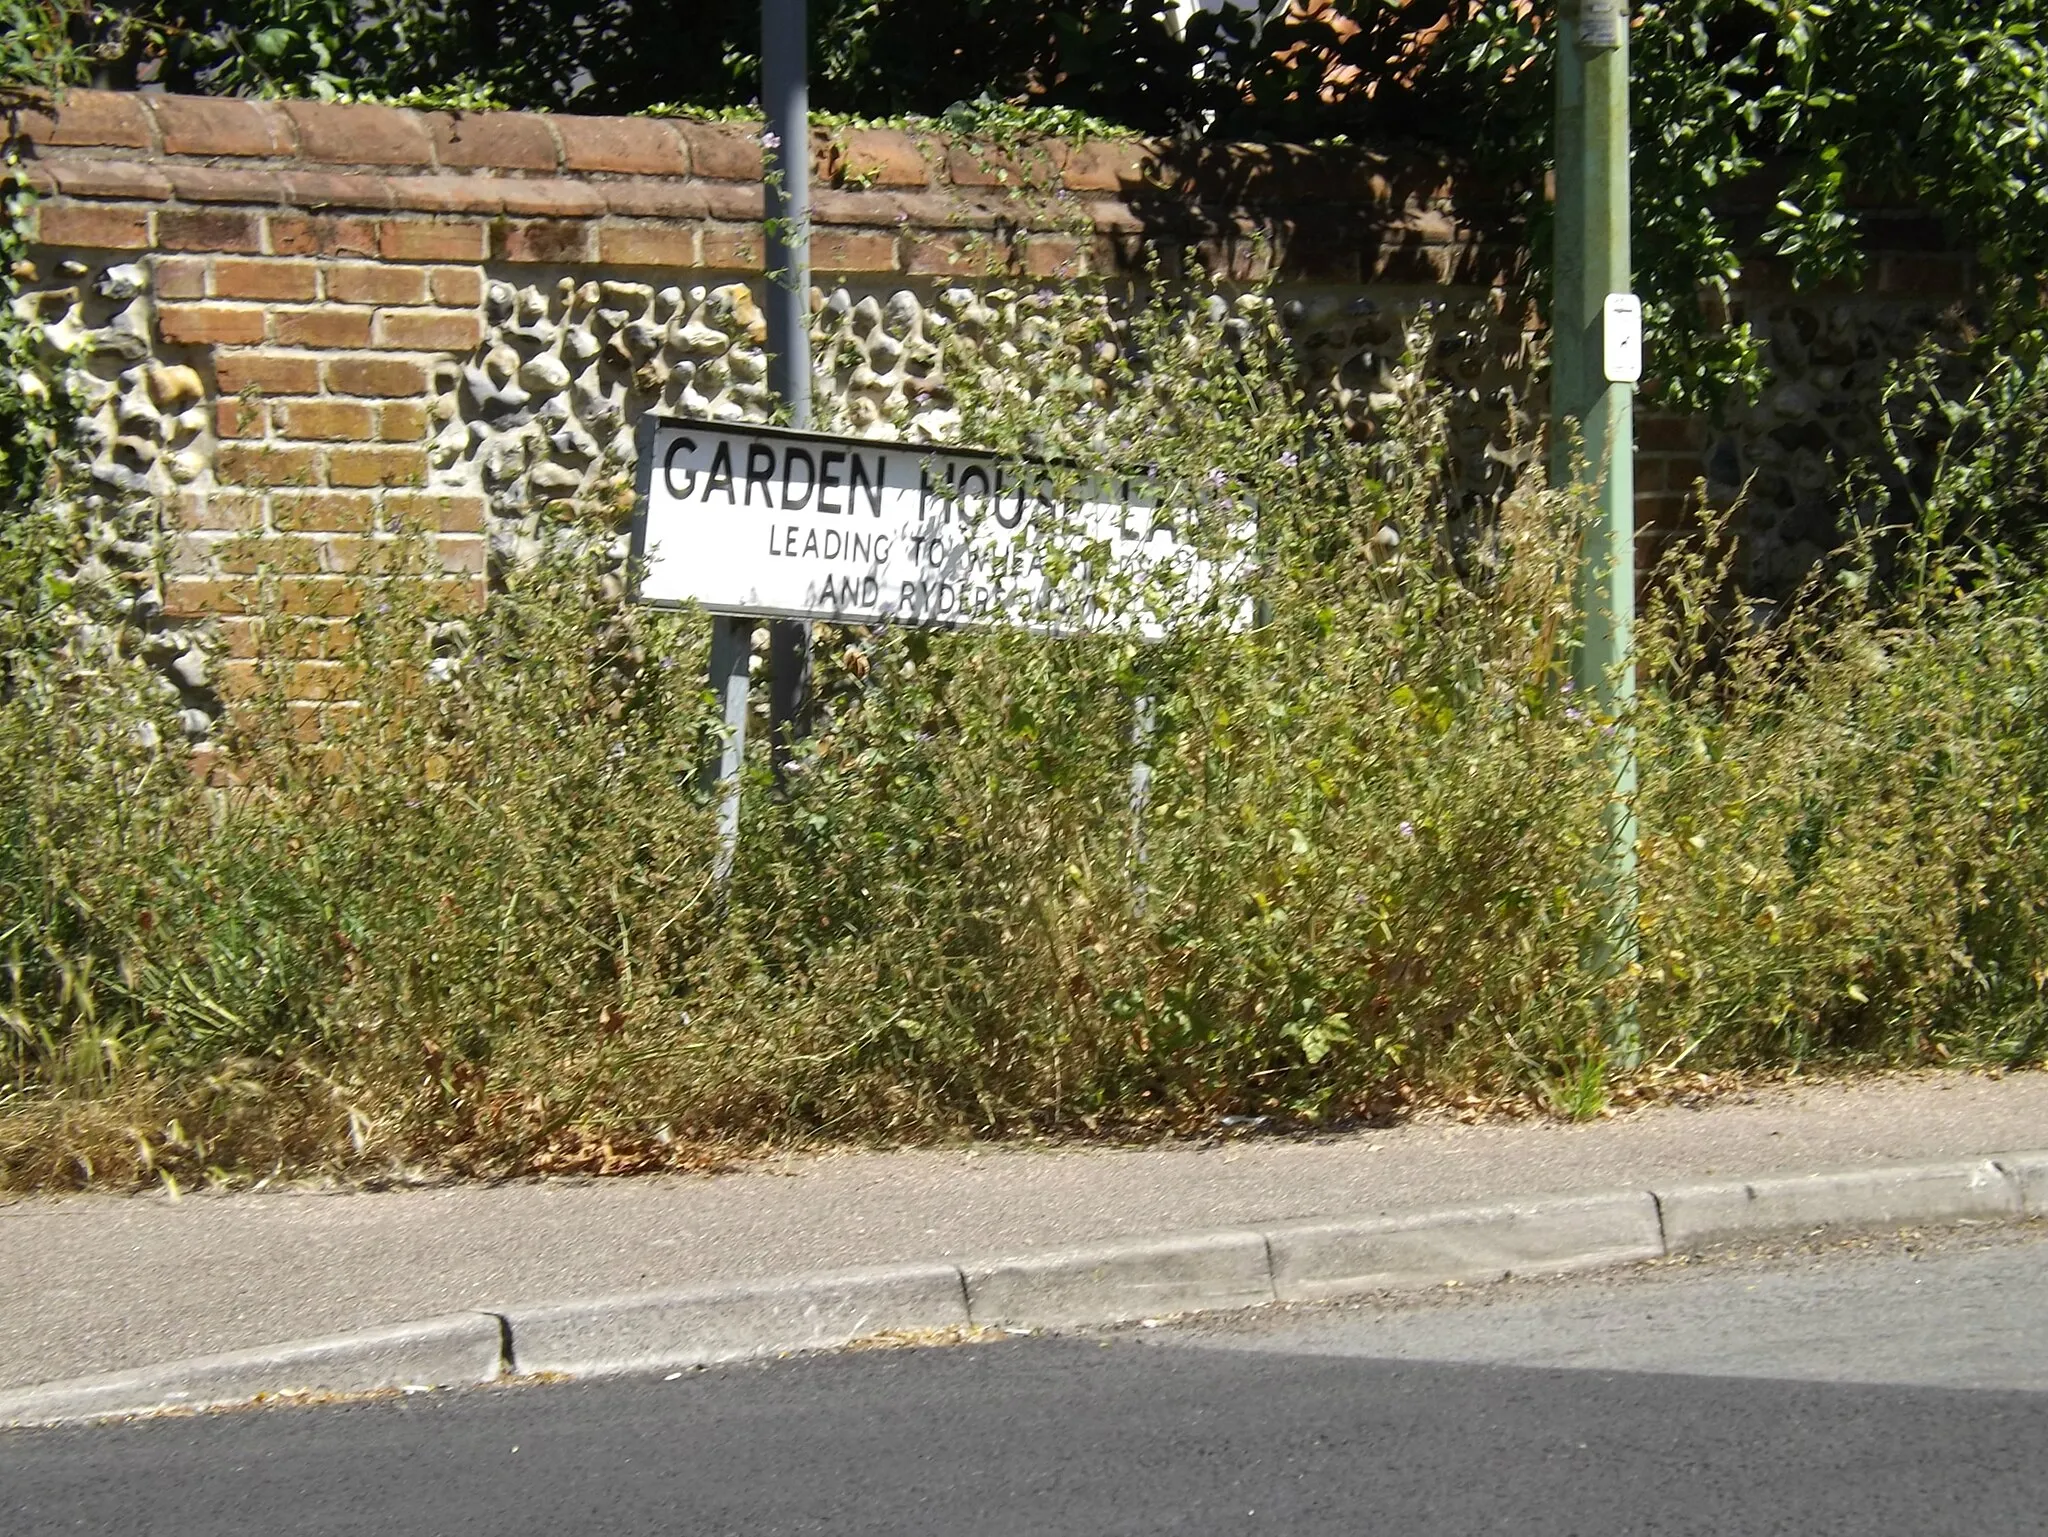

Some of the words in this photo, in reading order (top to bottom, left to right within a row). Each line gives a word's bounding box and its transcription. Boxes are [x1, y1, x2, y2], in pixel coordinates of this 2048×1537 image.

[664, 437, 887, 518] GARDEN
[918, 461, 1086, 536] HOUS
[769, 524, 889, 564] LEADING
[911, 536, 944, 568] TO
[819, 574, 878, 608] AND
